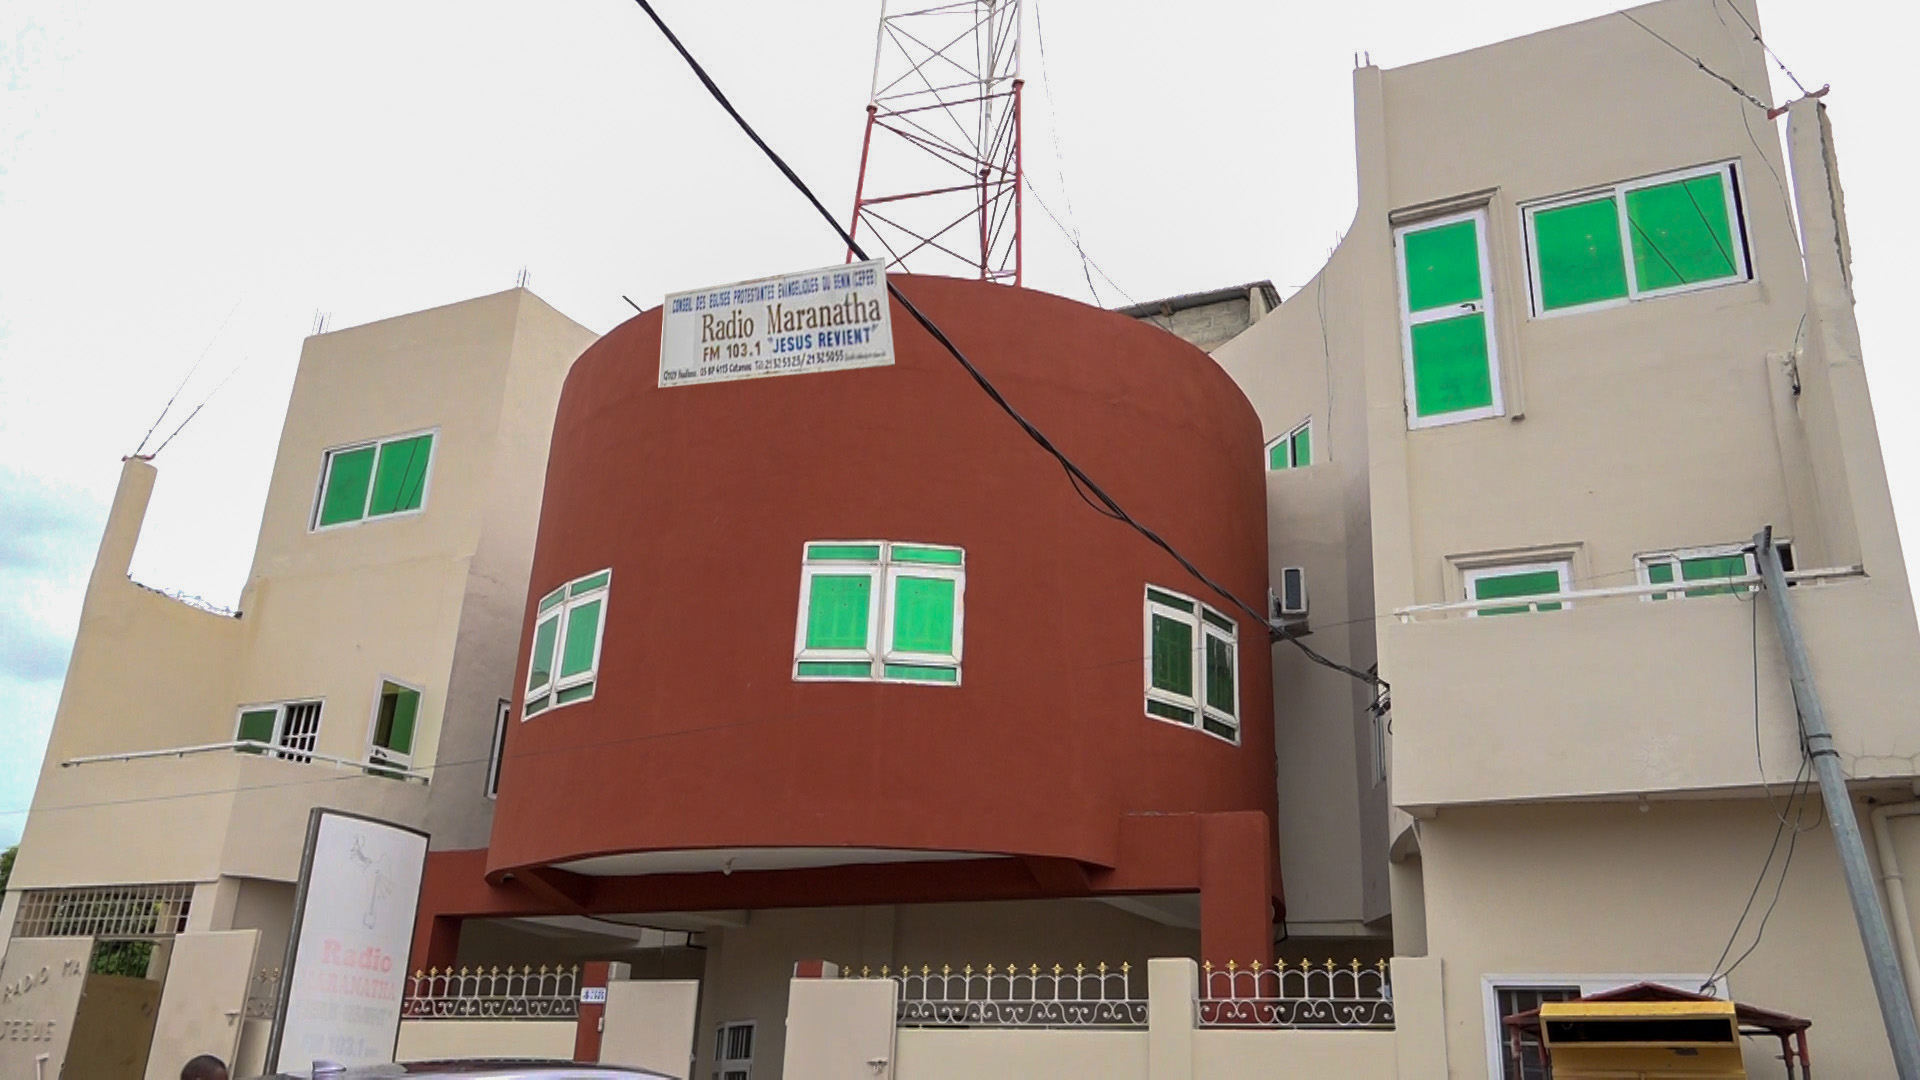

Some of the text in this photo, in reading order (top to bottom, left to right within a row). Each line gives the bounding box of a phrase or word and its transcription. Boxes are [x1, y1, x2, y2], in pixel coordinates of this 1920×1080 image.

[672, 299, 693, 314] CONSEIL
[695, 295, 706, 311] DES
[733, 284, 775, 305] PROTESTANTES
[701, 292, 882, 343] Radio Maranatha
[703, 341, 761, 363] FM 103.1
[320, 938, 393, 973] Radio
[3, 966, 49, 1003] RADIO
